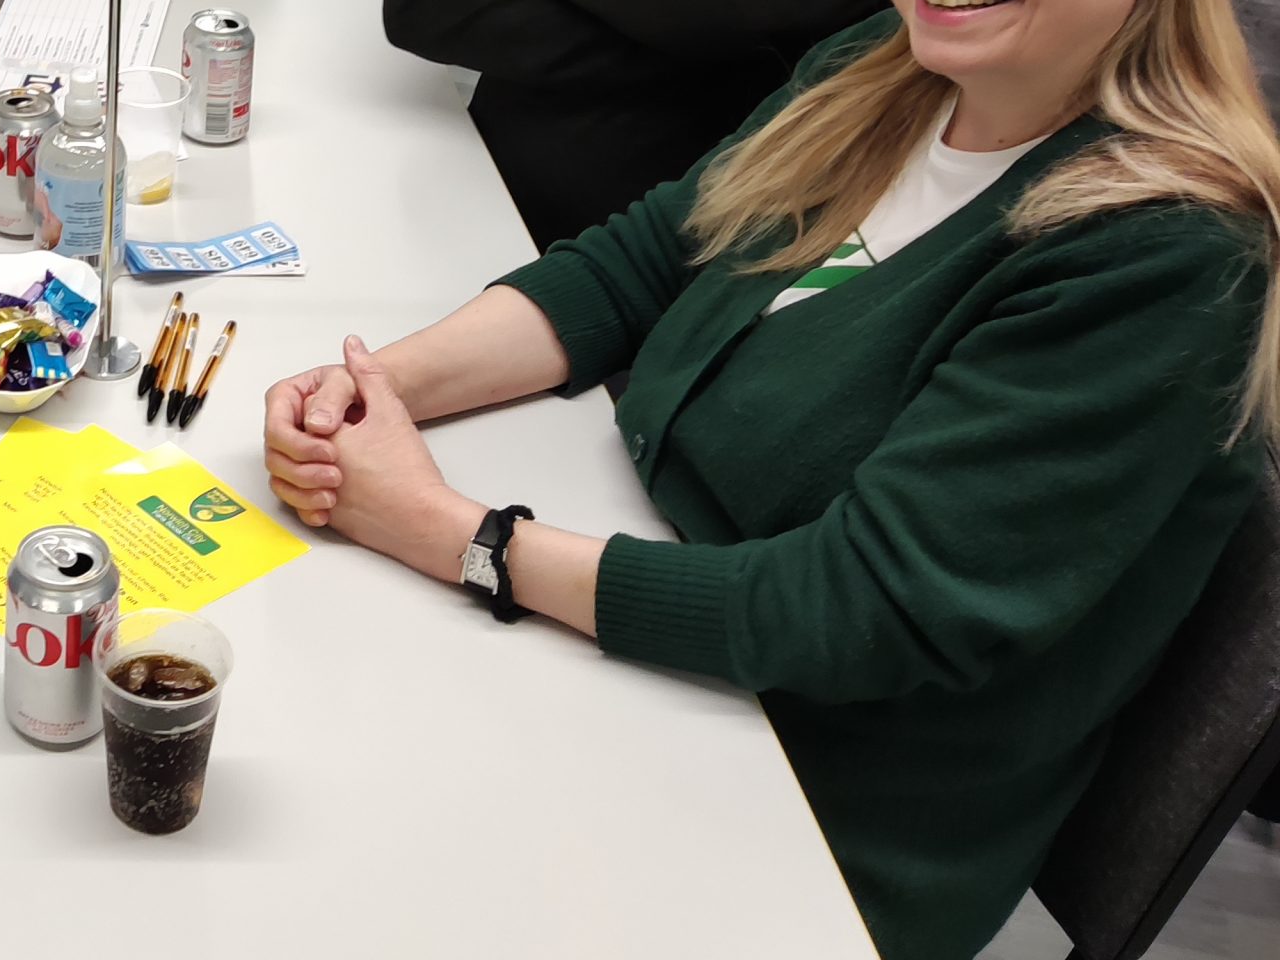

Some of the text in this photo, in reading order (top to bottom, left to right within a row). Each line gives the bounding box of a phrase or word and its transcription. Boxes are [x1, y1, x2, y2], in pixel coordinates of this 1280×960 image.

[232, 239, 259, 259] 649
[260, 229, 287, 250] 650
[155, 503, 189, 531] Norwich
[187, 528, 207, 544] City
